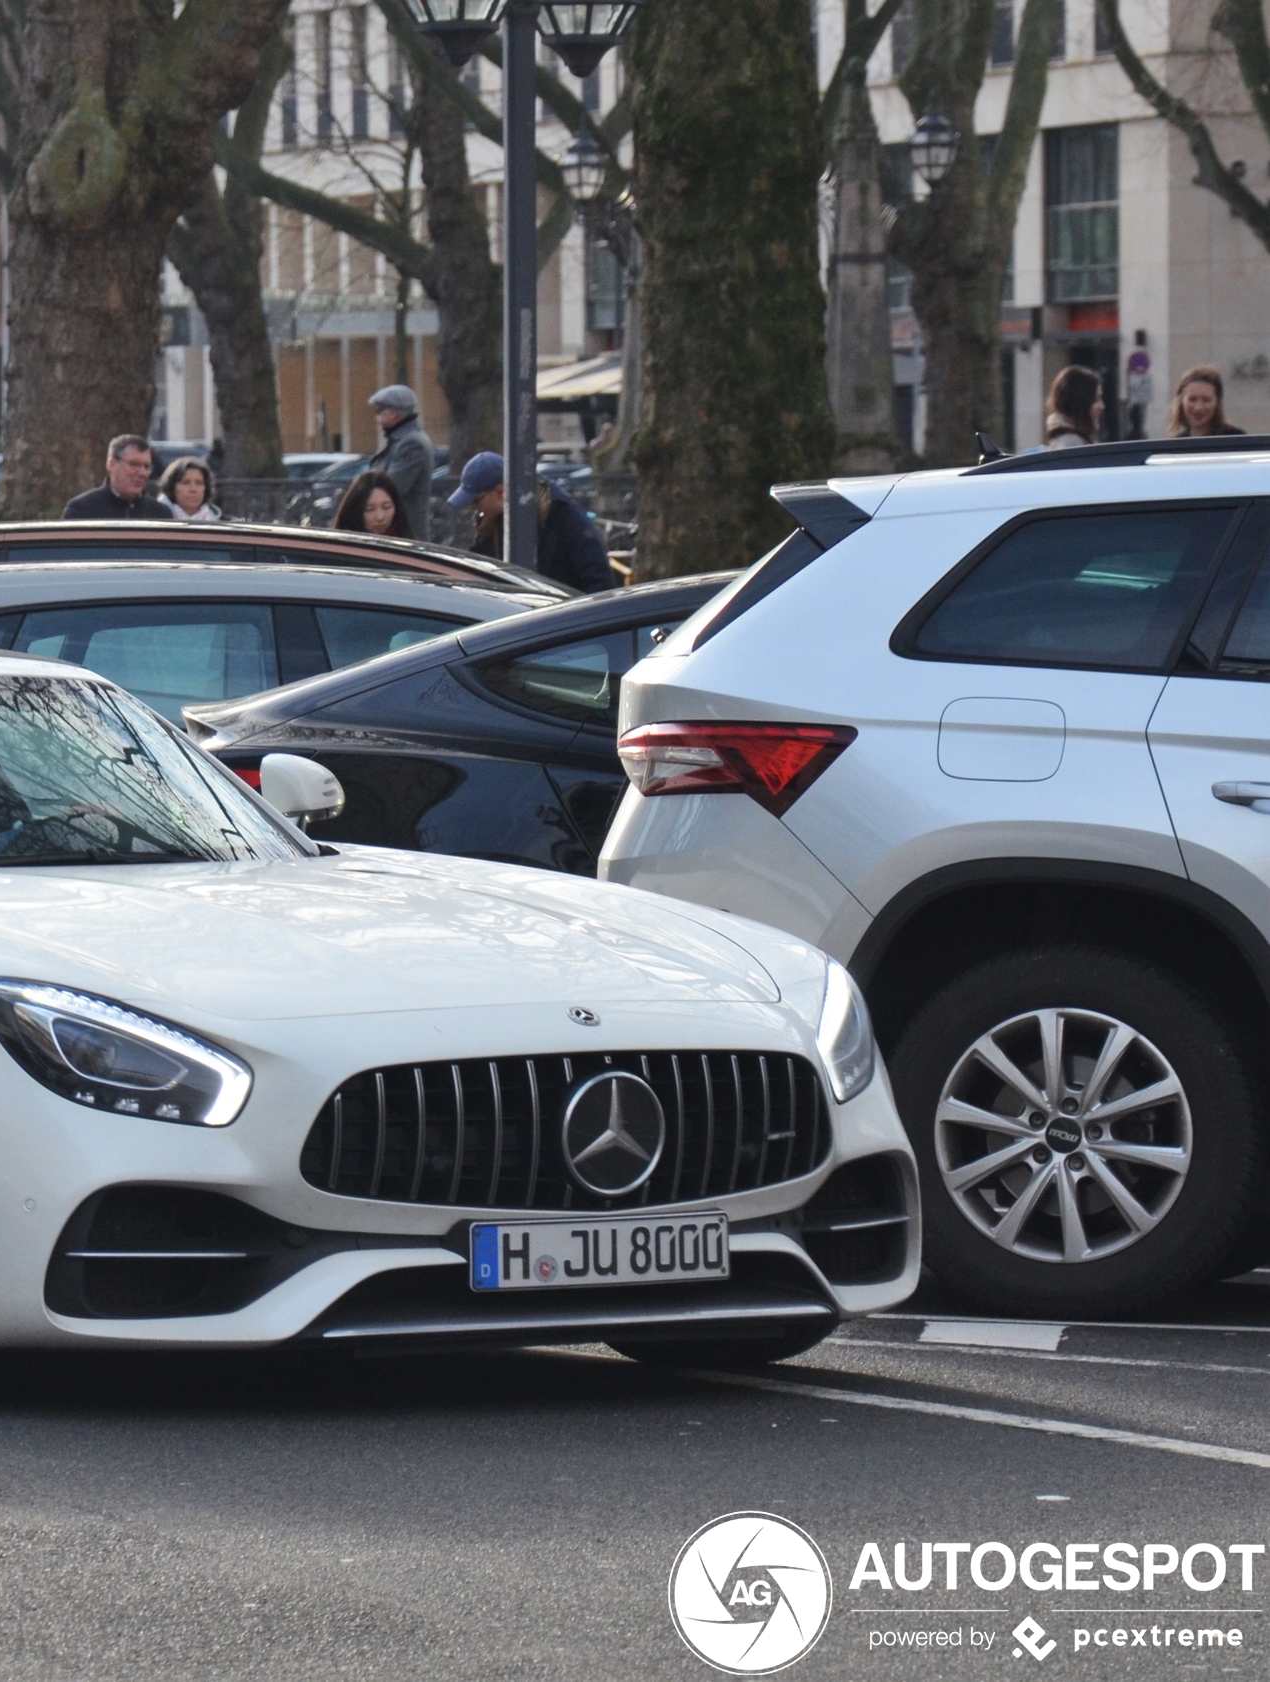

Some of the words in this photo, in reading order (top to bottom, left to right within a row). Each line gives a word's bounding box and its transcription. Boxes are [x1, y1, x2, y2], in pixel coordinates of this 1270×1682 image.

[502, 1232, 530, 1280] H
[564, 1229, 618, 1277] JU
[630, 1223, 724, 1274] 8000
[480, 1264, 491, 1278] D
